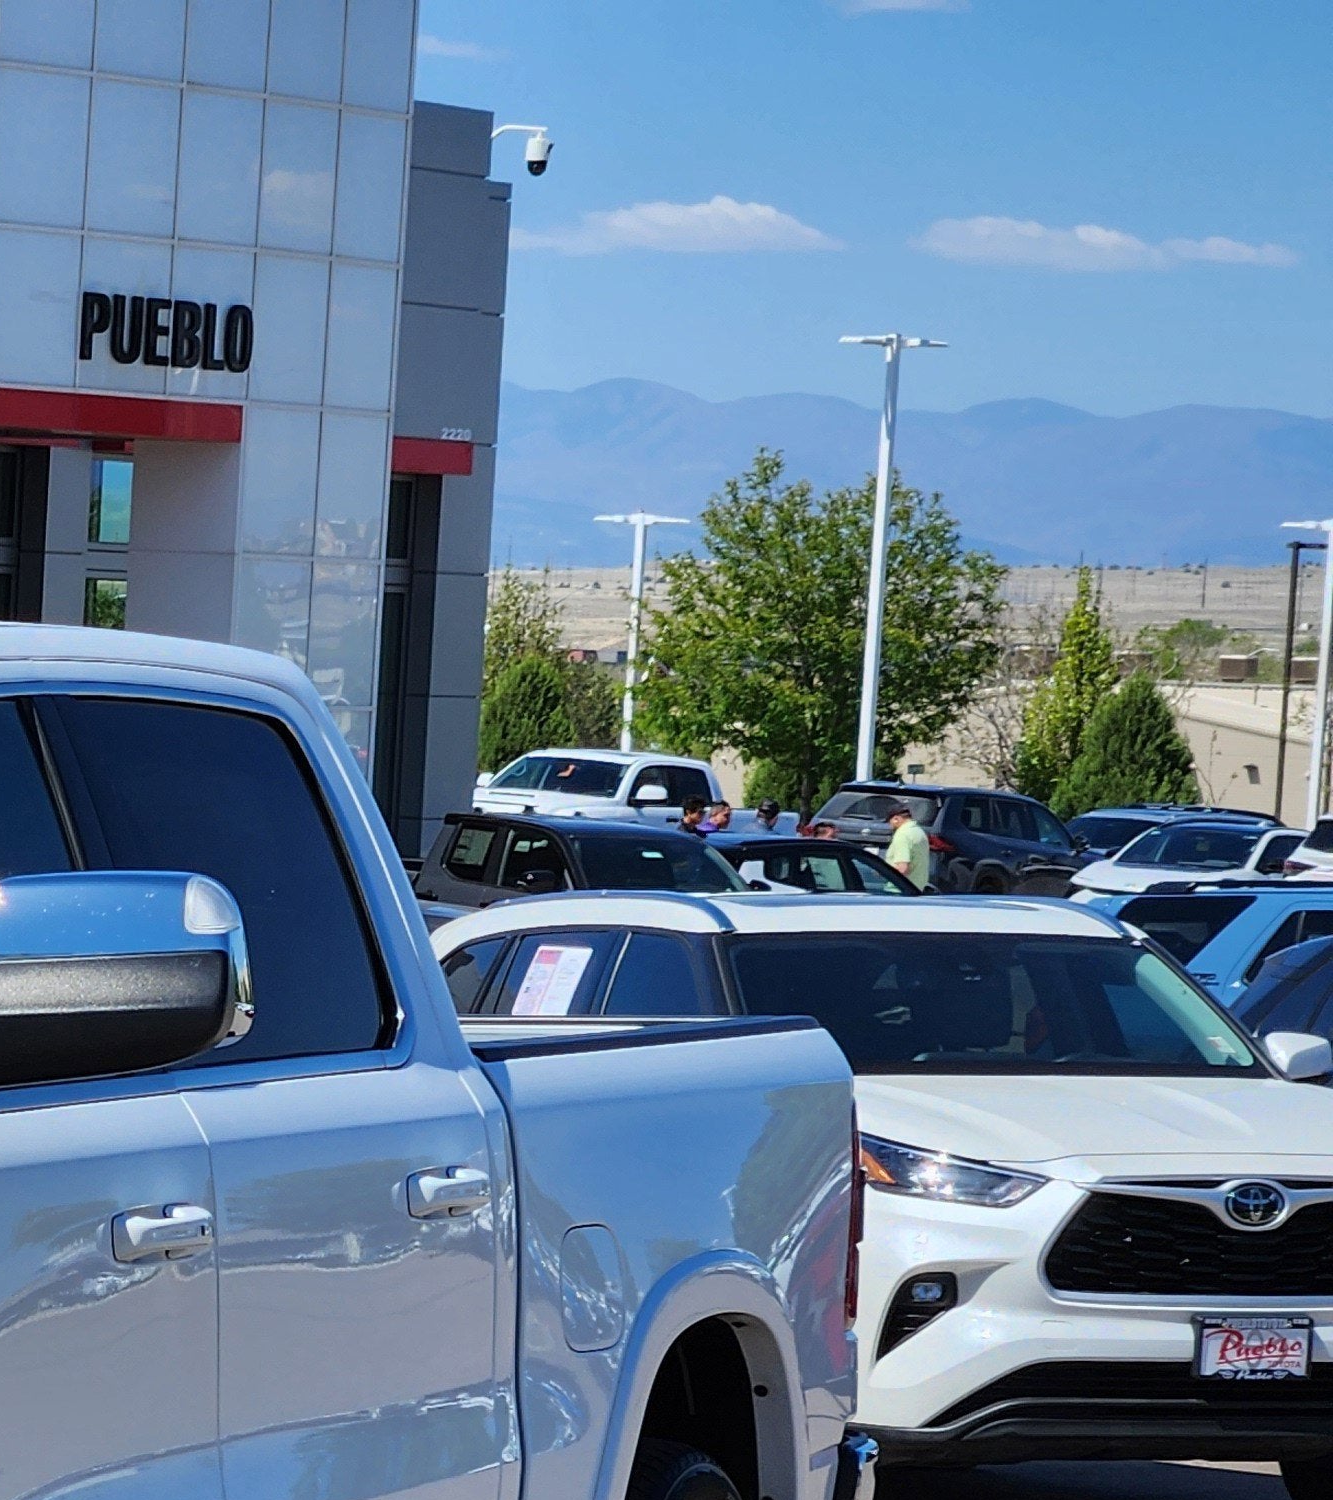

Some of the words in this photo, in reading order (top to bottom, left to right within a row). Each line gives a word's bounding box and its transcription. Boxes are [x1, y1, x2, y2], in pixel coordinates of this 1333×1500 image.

[78, 290, 254, 374] PUEBLO
[441, 427, 472, 442] 2220
[1205, 1329, 1303, 1361] Pueblo
